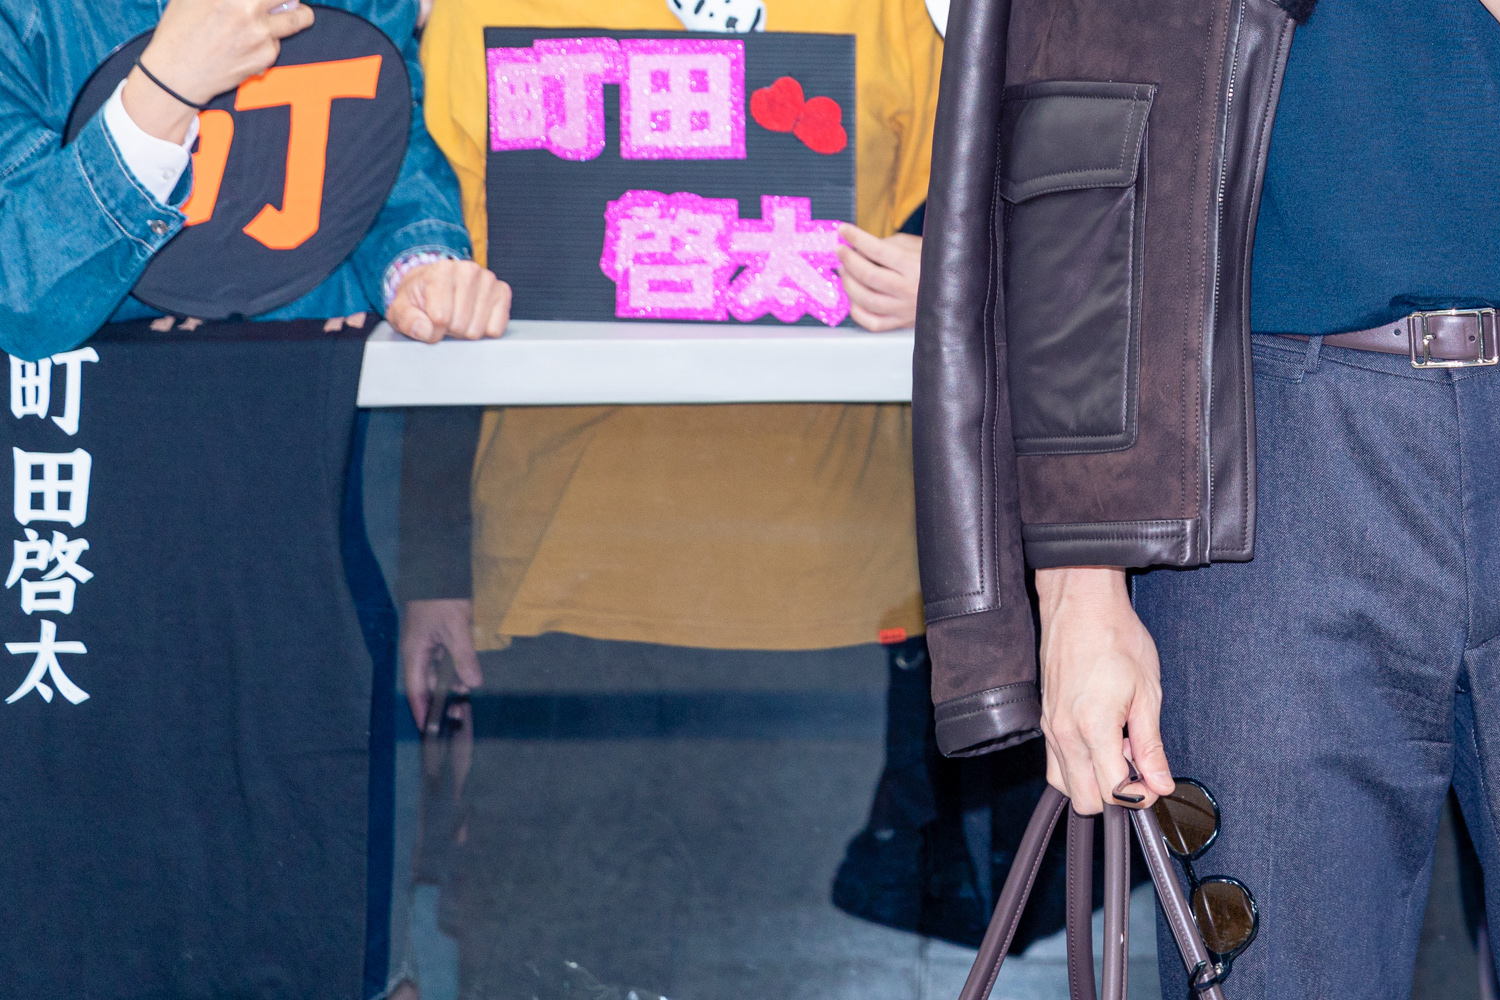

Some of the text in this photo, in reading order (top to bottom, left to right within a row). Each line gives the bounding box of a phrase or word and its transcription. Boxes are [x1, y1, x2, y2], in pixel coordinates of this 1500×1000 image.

[487, 37, 746, 160] 町田
[600, 189, 852, 326] 啓太
[4, 346, 100, 705] 町田啓太
